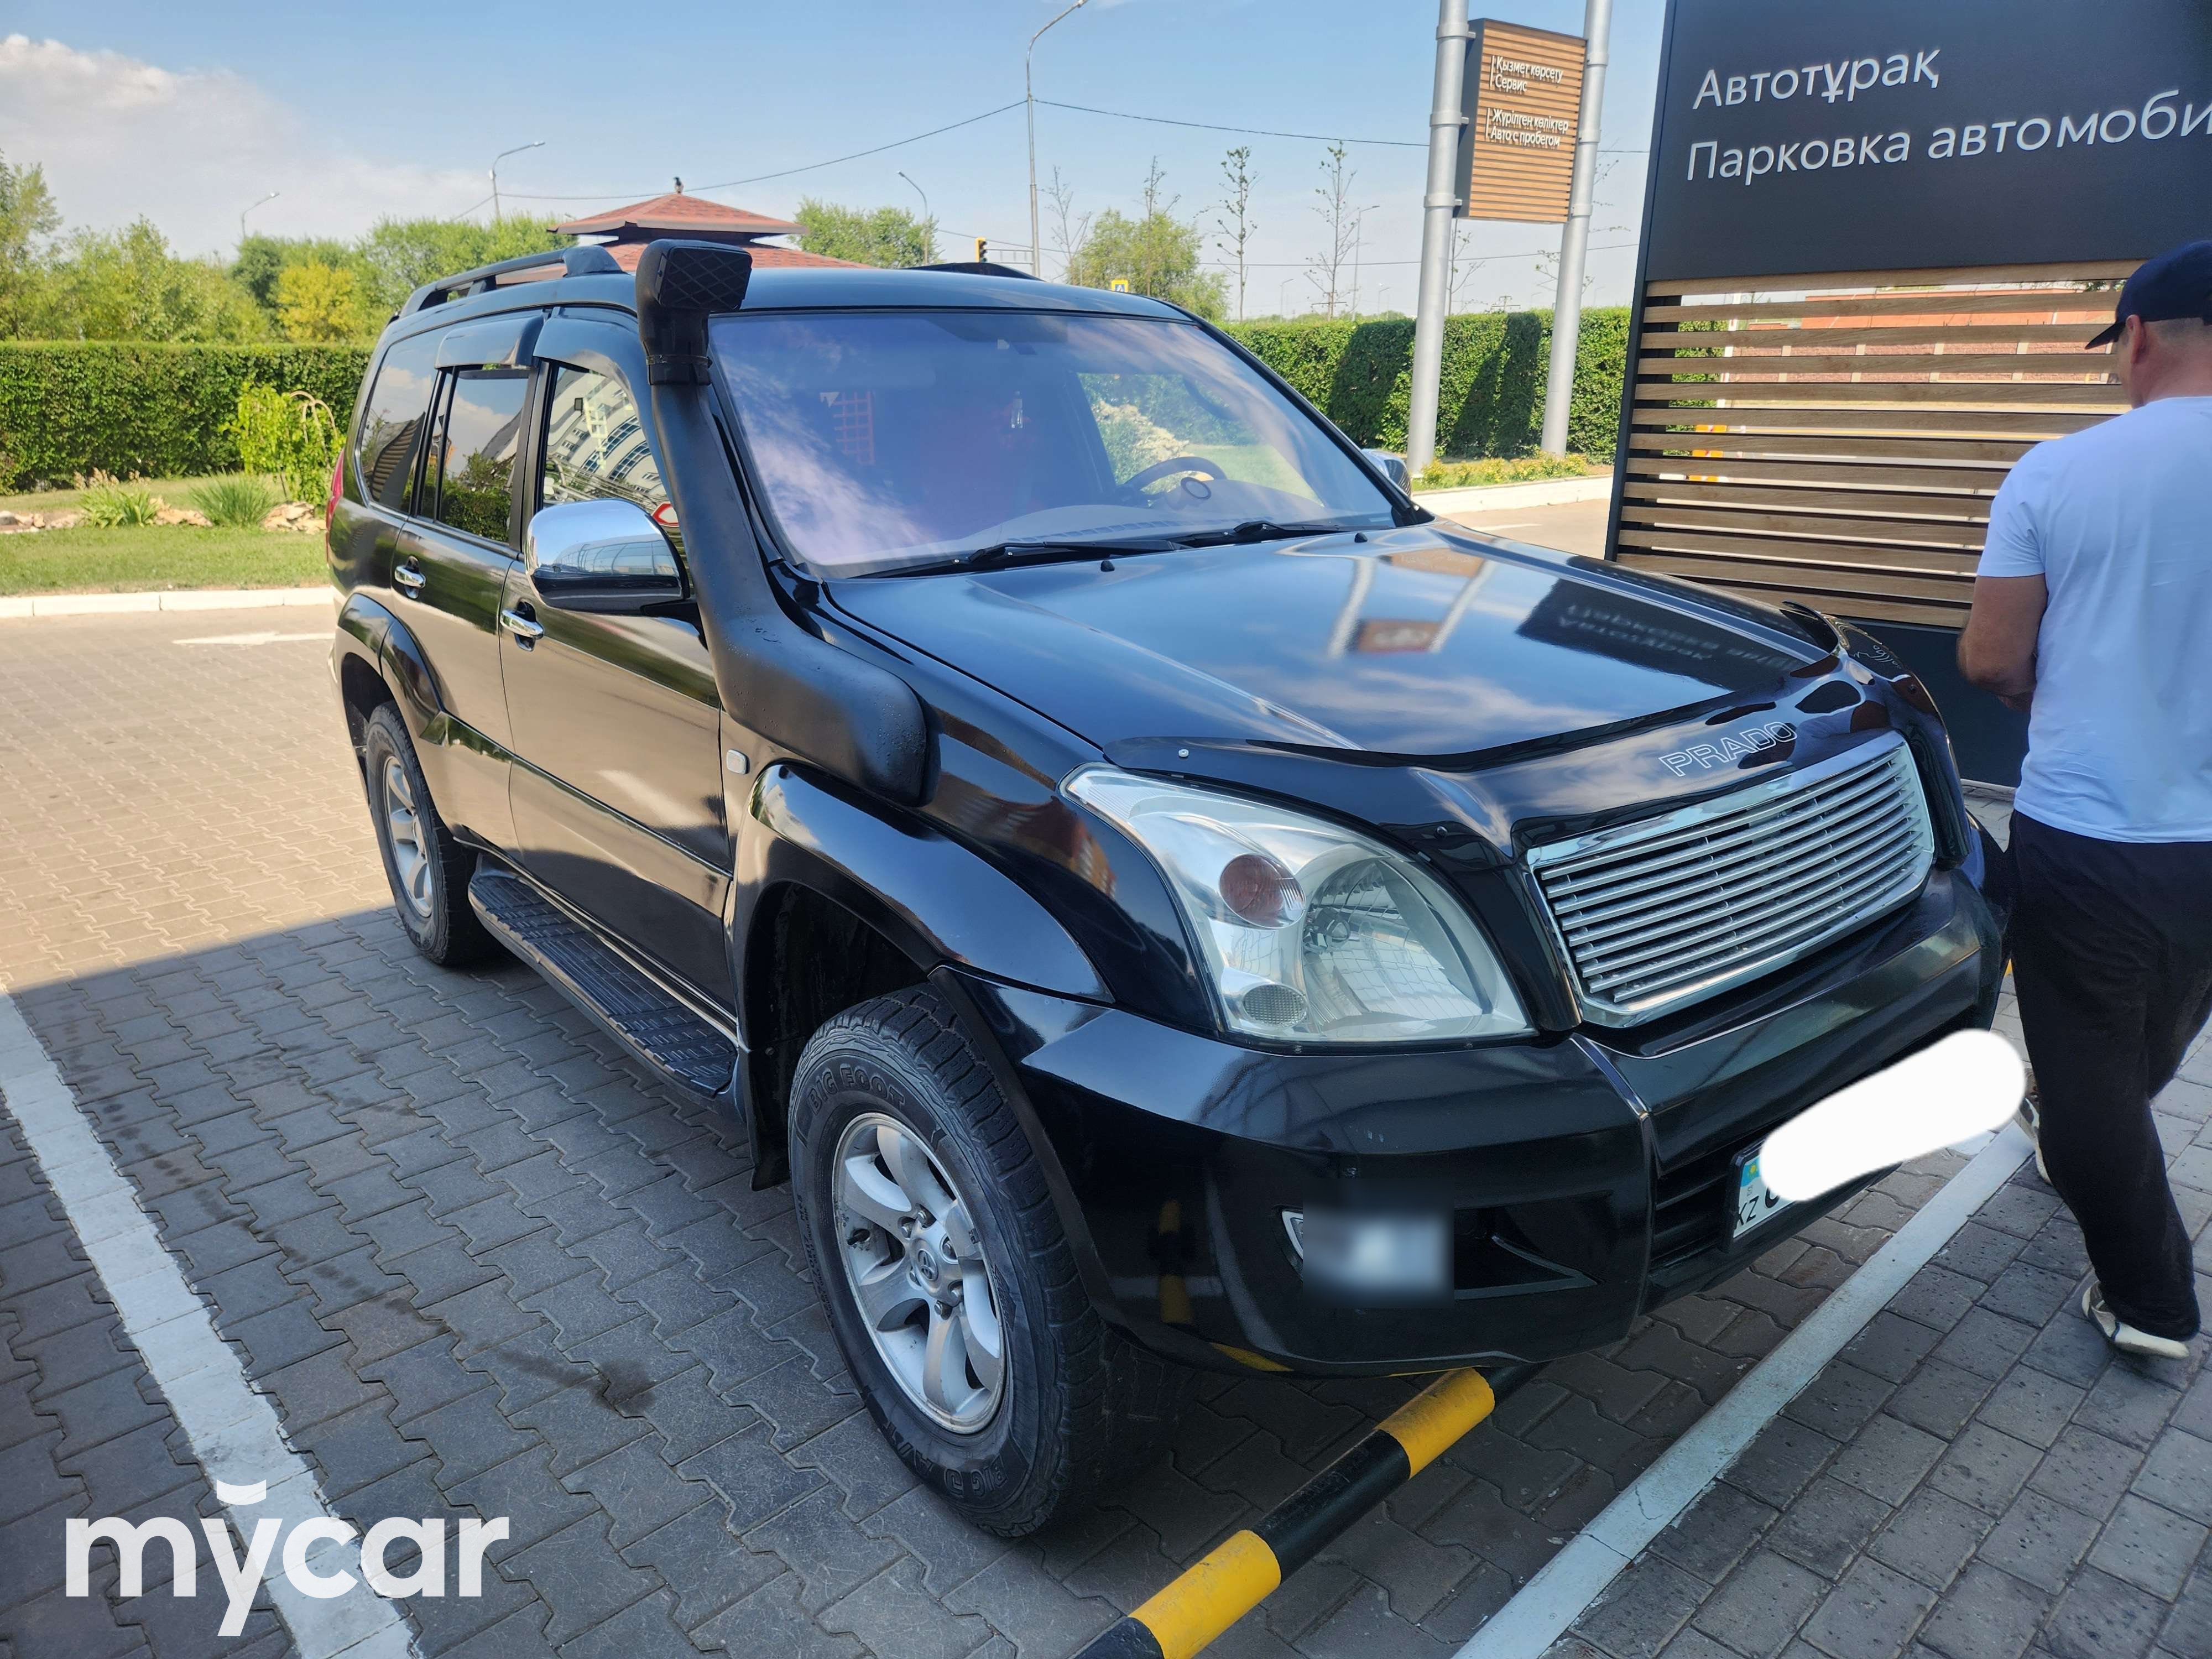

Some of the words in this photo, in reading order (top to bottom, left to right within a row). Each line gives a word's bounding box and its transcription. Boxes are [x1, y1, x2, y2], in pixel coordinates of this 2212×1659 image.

[1495, 74, 1528, 92] Сервис
[1496, 56, 1530, 74] Қызмет
[1531, 65, 1564, 84] көрсету
[1693, 48, 1941, 110] Автотұрақ
[1490, 126, 1512, 141] Авто
[1512, 132, 1519, 142] с
[1520, 131, 1561, 147] пробегом
[1492, 108, 1533, 127] Жүрілген
[1687, 131, 1910, 186] Парковка
[1928, 89, 2212, 159] автомоби
[1658, 722, 1798, 777] PRADO
[807, 1068, 838, 1115] BIG
[839, 1063, 905, 1109] FOOT
